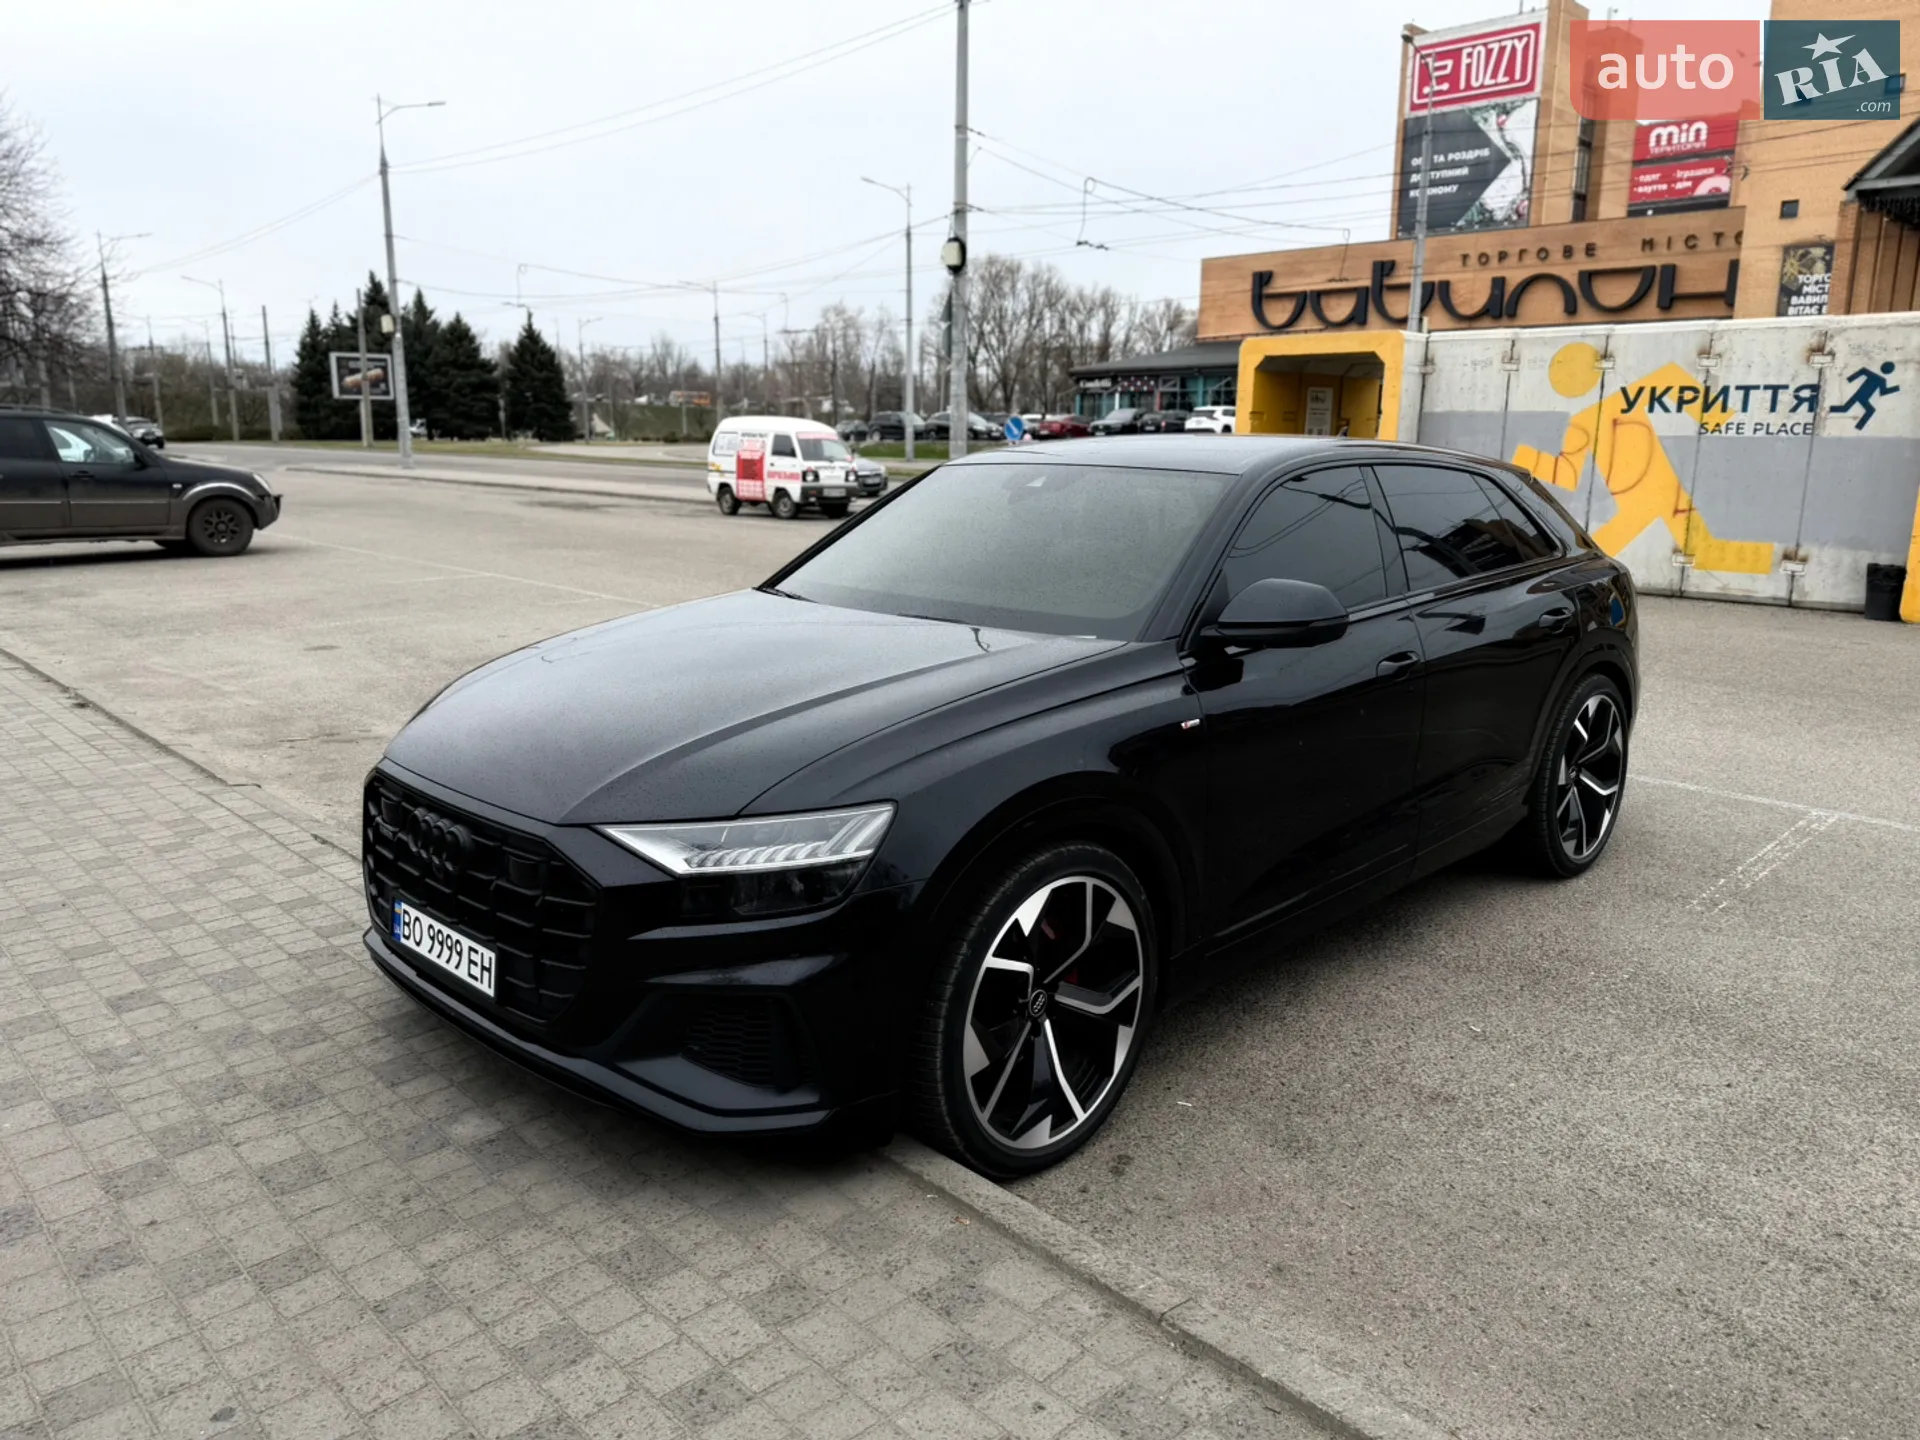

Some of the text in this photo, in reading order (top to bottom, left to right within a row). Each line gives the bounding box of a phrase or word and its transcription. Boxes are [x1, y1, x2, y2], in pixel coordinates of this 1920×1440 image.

[1459, 36, 1529, 90] FOZZY
[1433, 153, 1446, 164] ТА
[1447, 147, 1491, 161] РОЗДРІБ
[1460, 242, 1597, 268] ТОРГОВЕ
[1620, 383, 1820, 414] УКРИТТЯ
[1700, 421, 1814, 436] SAFE PLACE
[402, 908, 493, 989] BO 9999 EH
